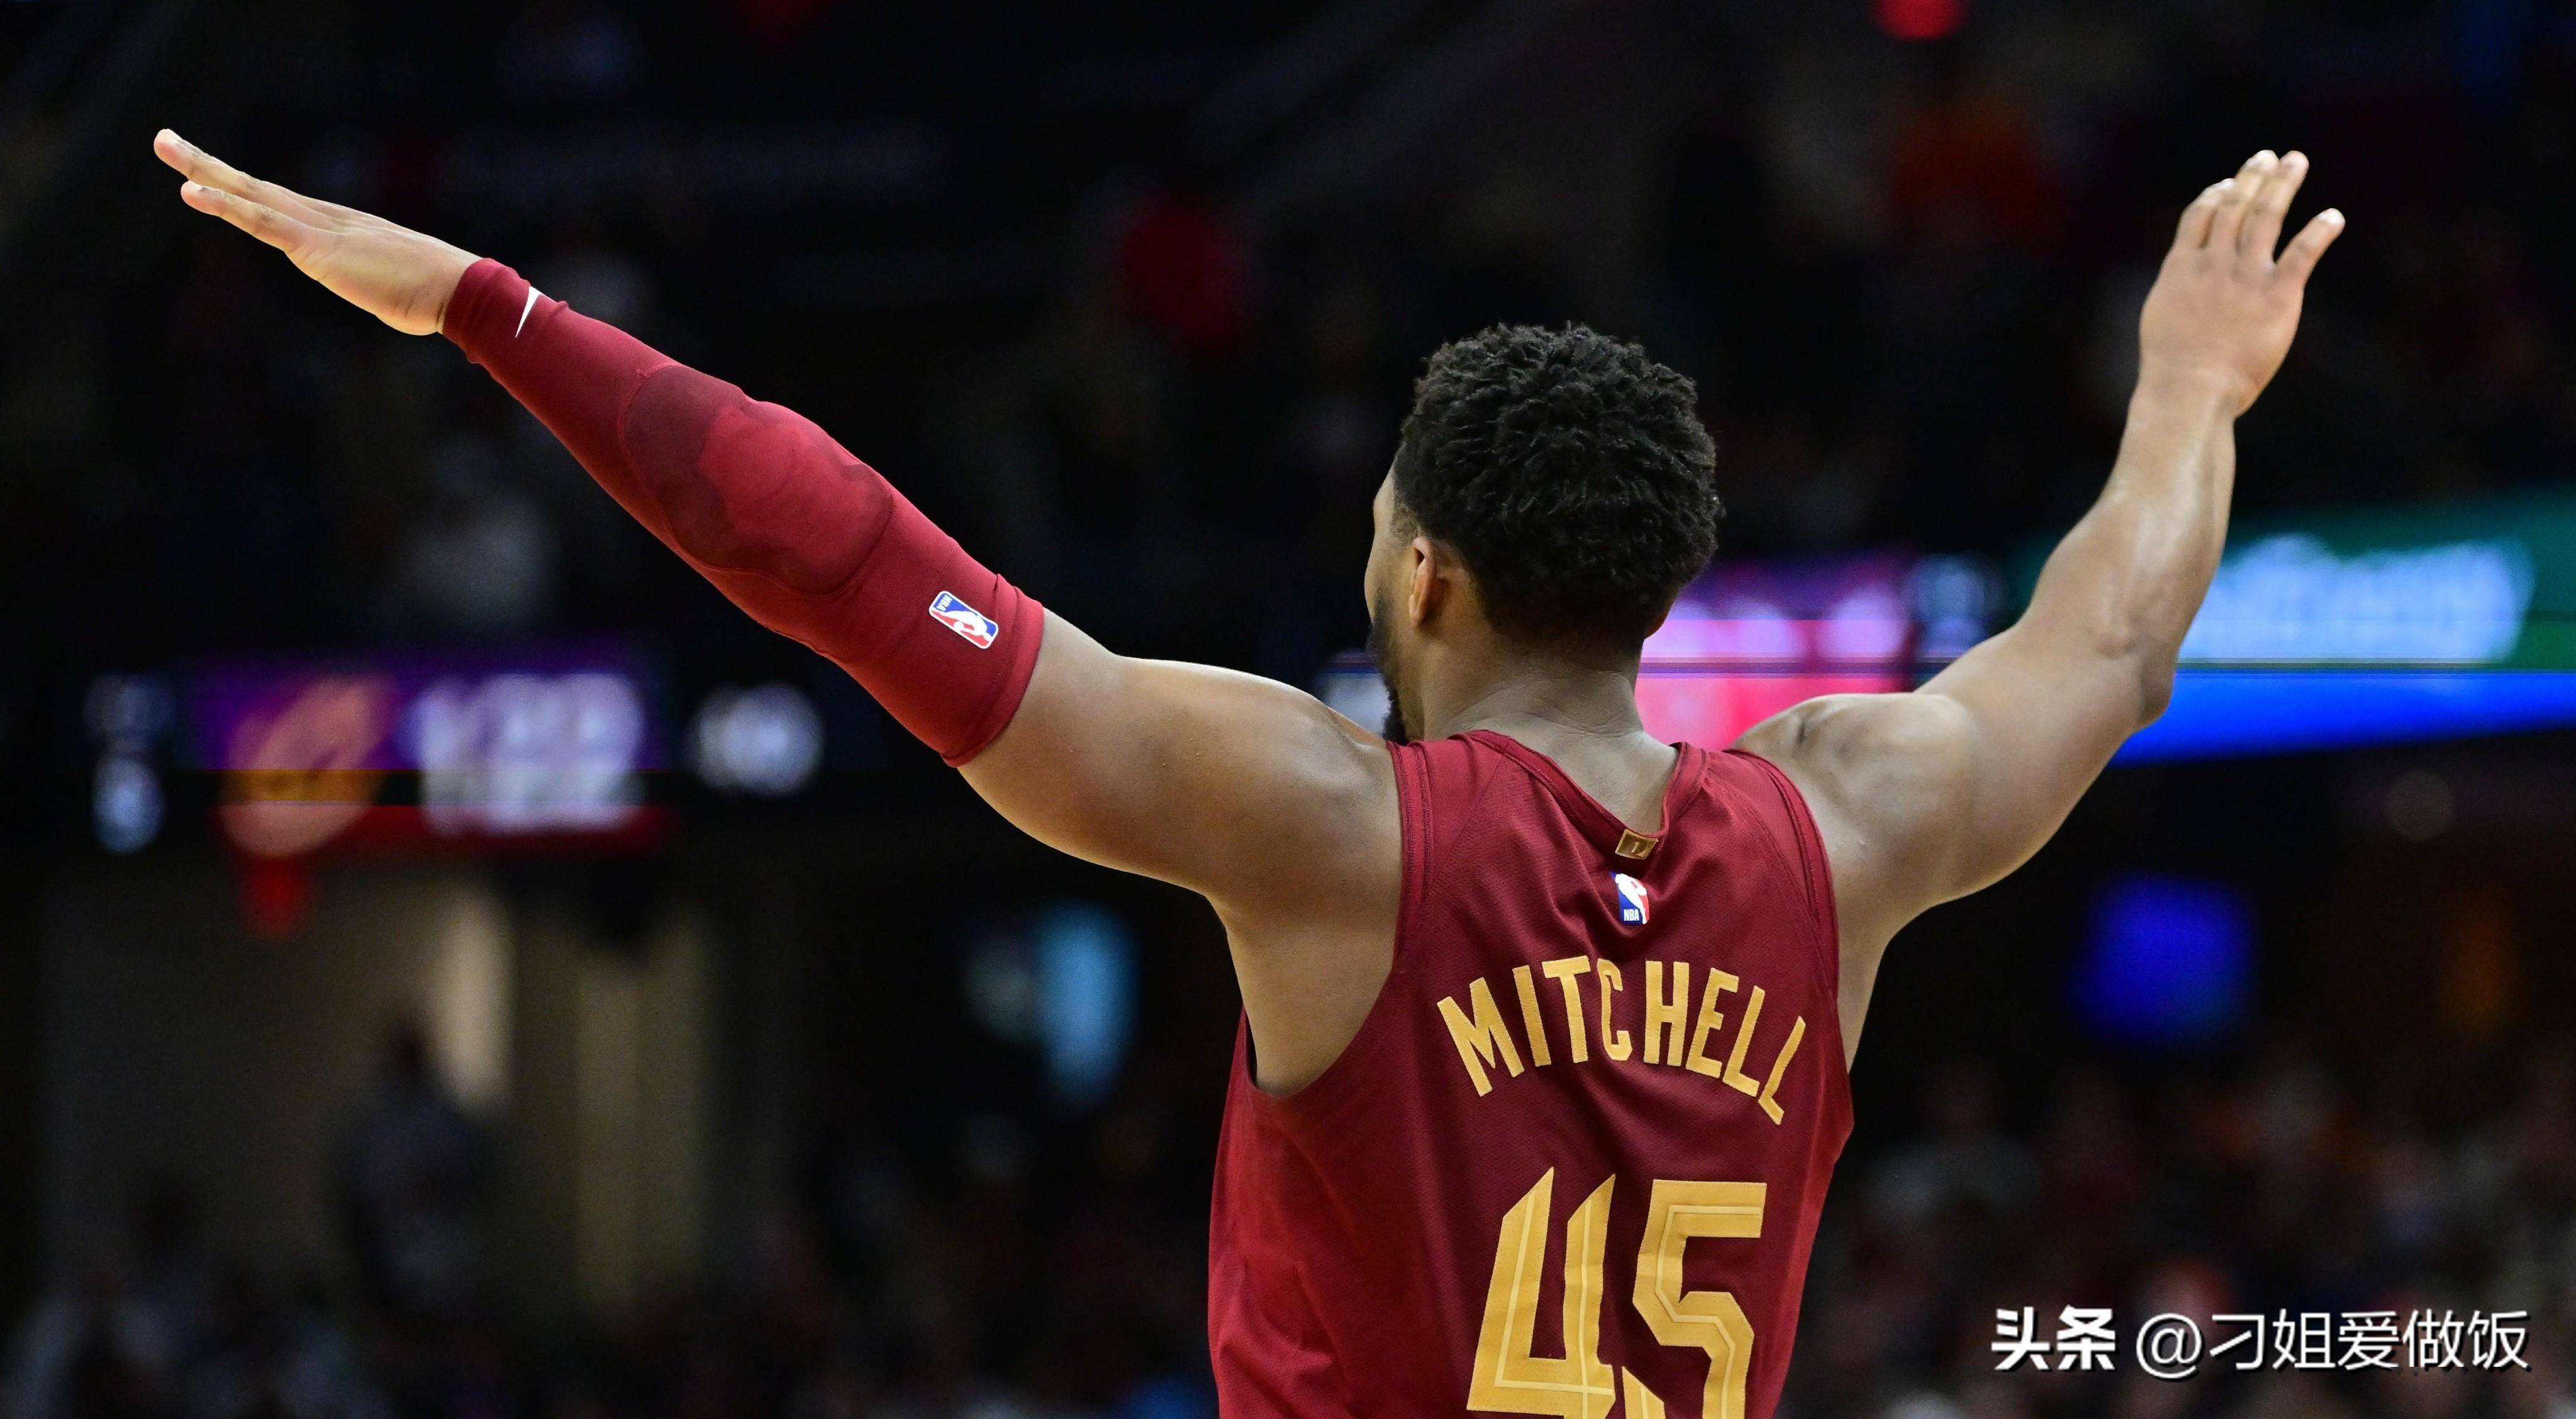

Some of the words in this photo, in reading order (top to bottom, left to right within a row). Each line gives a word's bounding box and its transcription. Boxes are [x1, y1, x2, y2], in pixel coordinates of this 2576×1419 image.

[936, 594, 952, 611] NBA
[1623, 909, 1640, 921] NBA
[1437, 955, 1806, 1125] MITCHELL
[1466, 1167, 1767, 1419] 45
